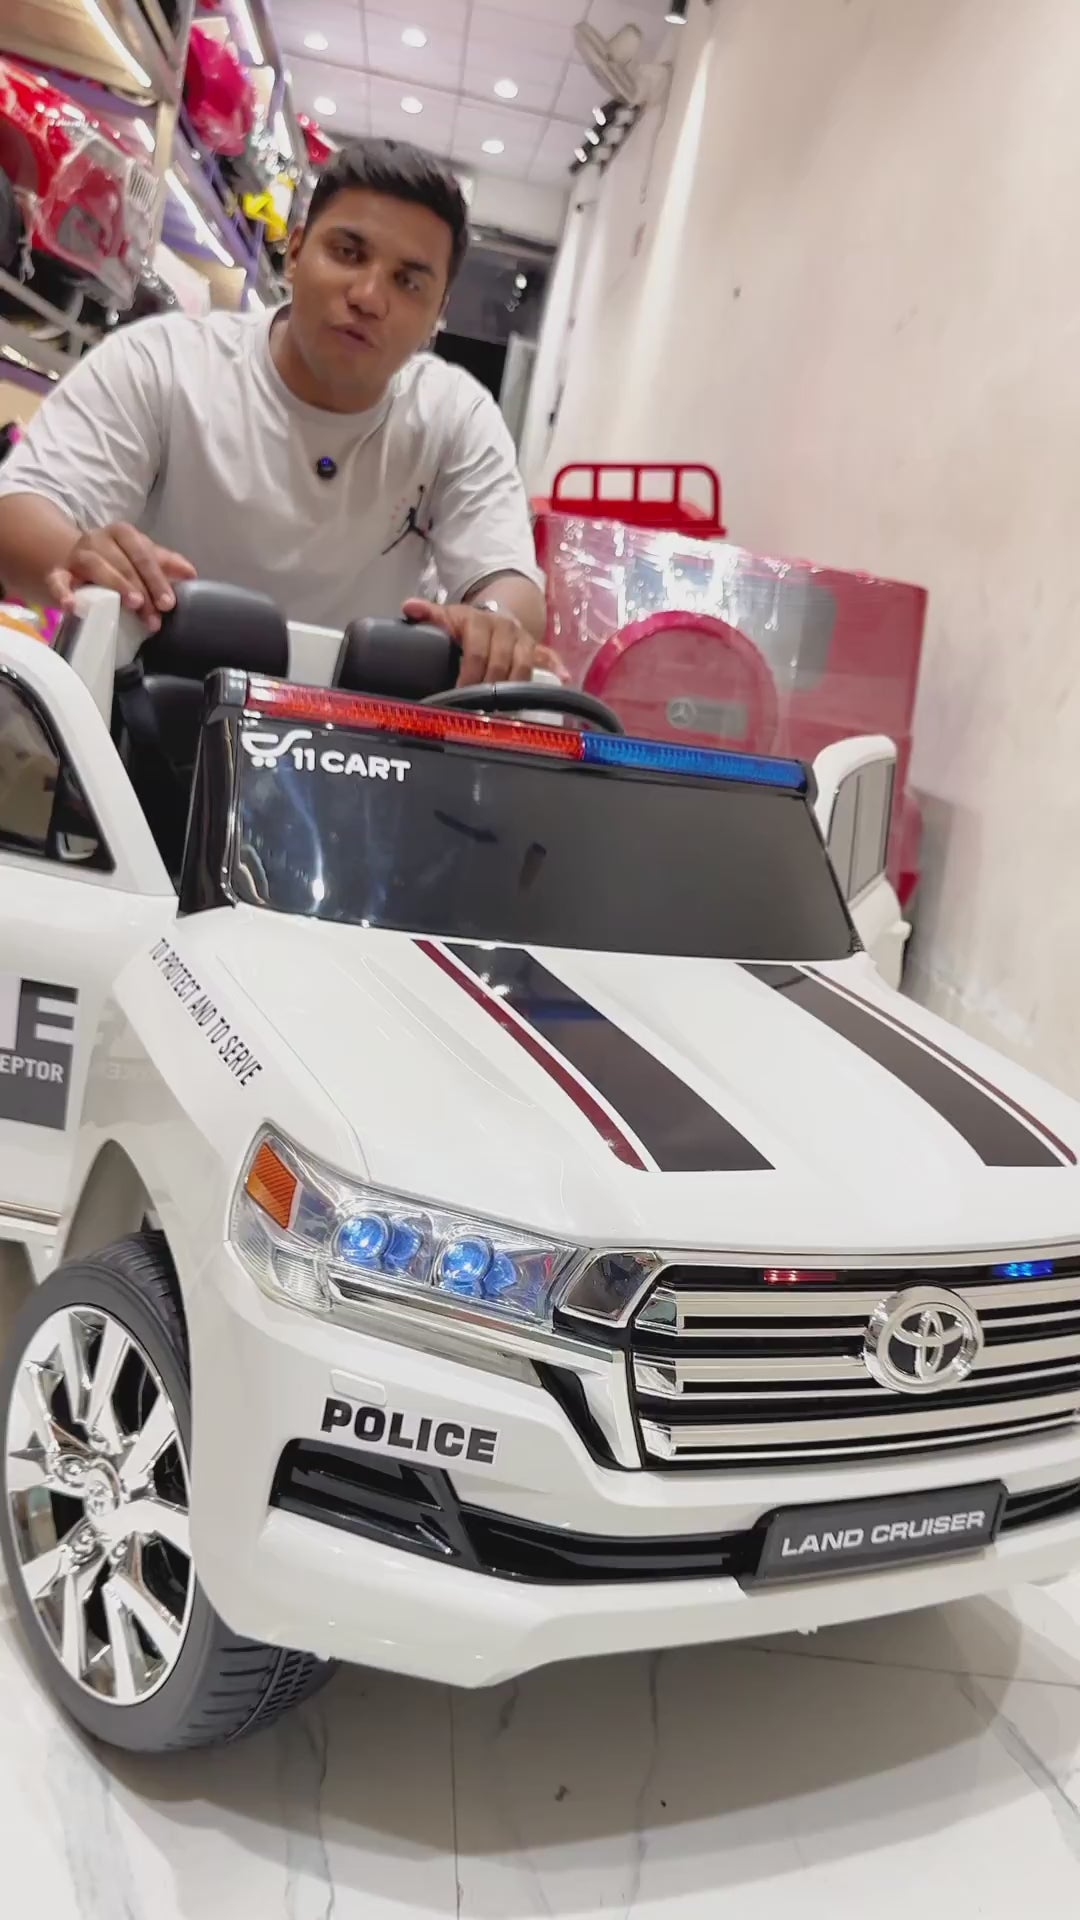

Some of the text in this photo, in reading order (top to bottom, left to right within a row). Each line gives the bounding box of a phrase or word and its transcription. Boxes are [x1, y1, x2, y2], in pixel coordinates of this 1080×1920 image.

[292, 747, 411, 782] 11 CART
[149, 937, 263, 1087] TO PROTECT AND TO SERVE
[320, 1397, 498, 1464] POLICE
[781, 1510, 985, 1557] LAND CRUISER
